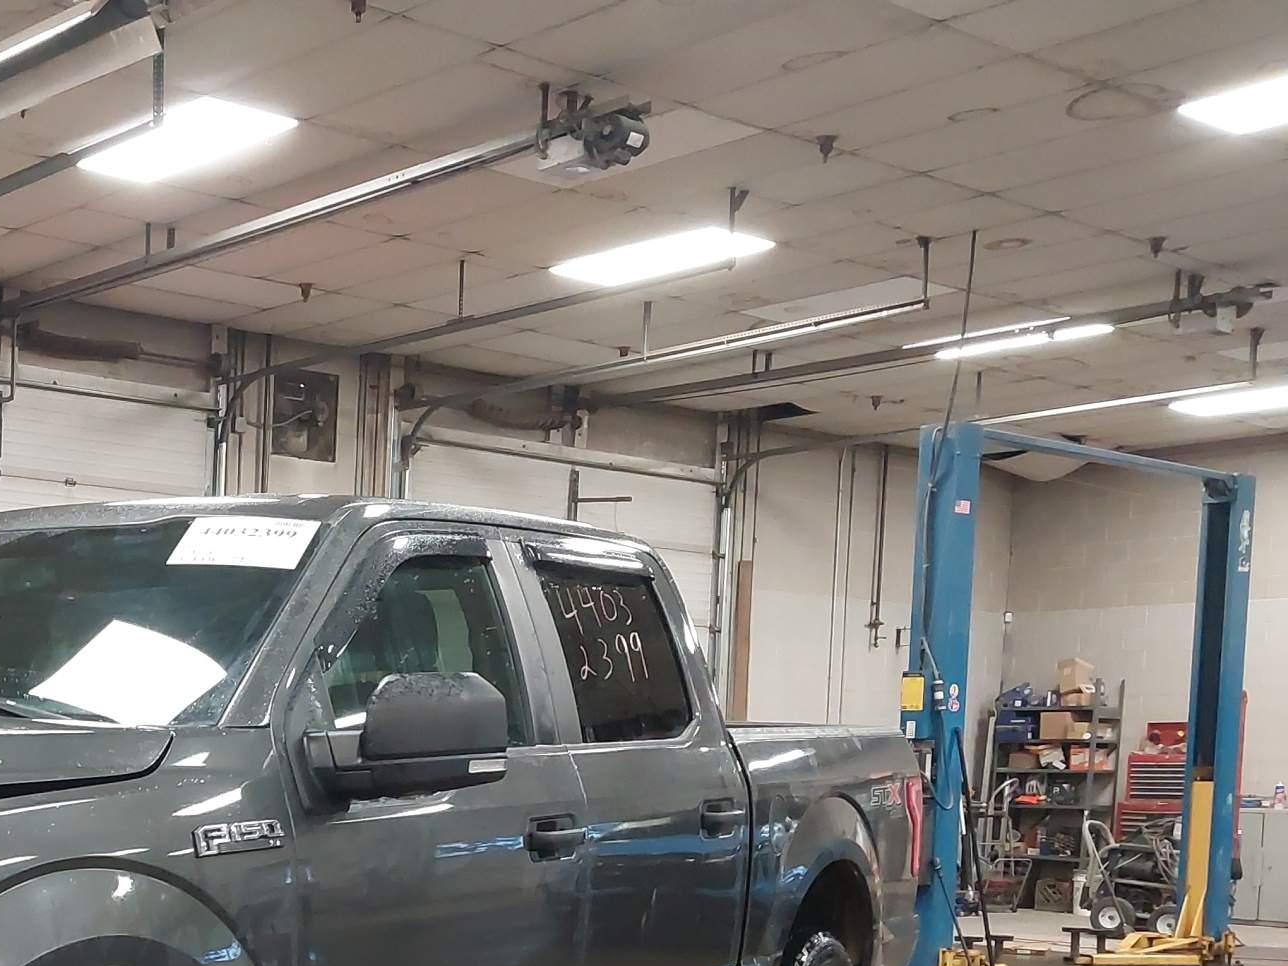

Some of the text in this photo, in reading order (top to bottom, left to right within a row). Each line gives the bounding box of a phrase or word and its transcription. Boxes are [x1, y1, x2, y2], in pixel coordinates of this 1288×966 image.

[555, 586, 632, 636] 4403
[580, 631, 649, 682] 2399
[870, 783, 902, 807] STX
